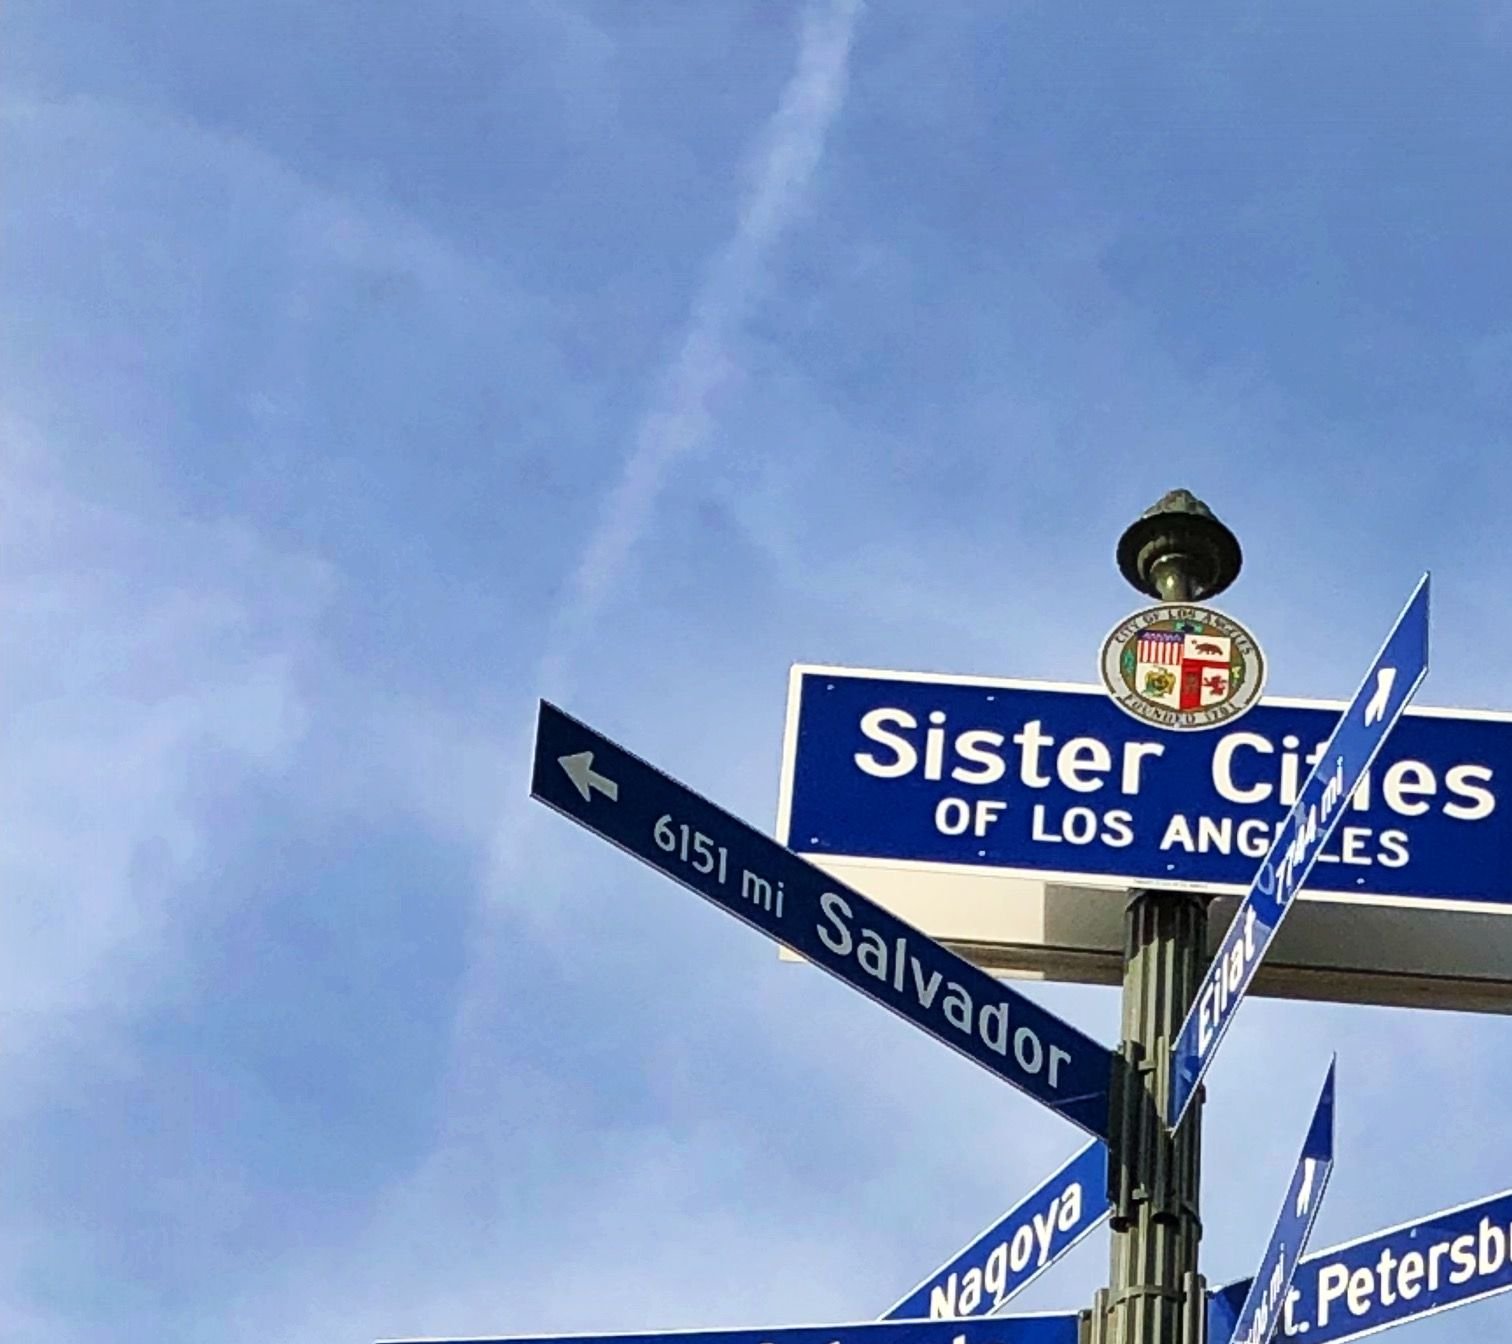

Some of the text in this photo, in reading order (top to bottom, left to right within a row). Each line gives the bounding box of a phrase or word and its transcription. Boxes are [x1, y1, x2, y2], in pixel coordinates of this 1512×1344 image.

[853, 707, 1497, 819] Sister Cies
[935, 798, 1410, 867] OF LOS ANGES
[653, 814, 1072, 1088] 6151 mi Salvador
[1198, 903, 1257, 1058] Eilat
[1321, 755, 1344, 823] mi
[928, 1181, 1083, 1320] Nagoya
[1284, 1284, 1309, 1336] t.
